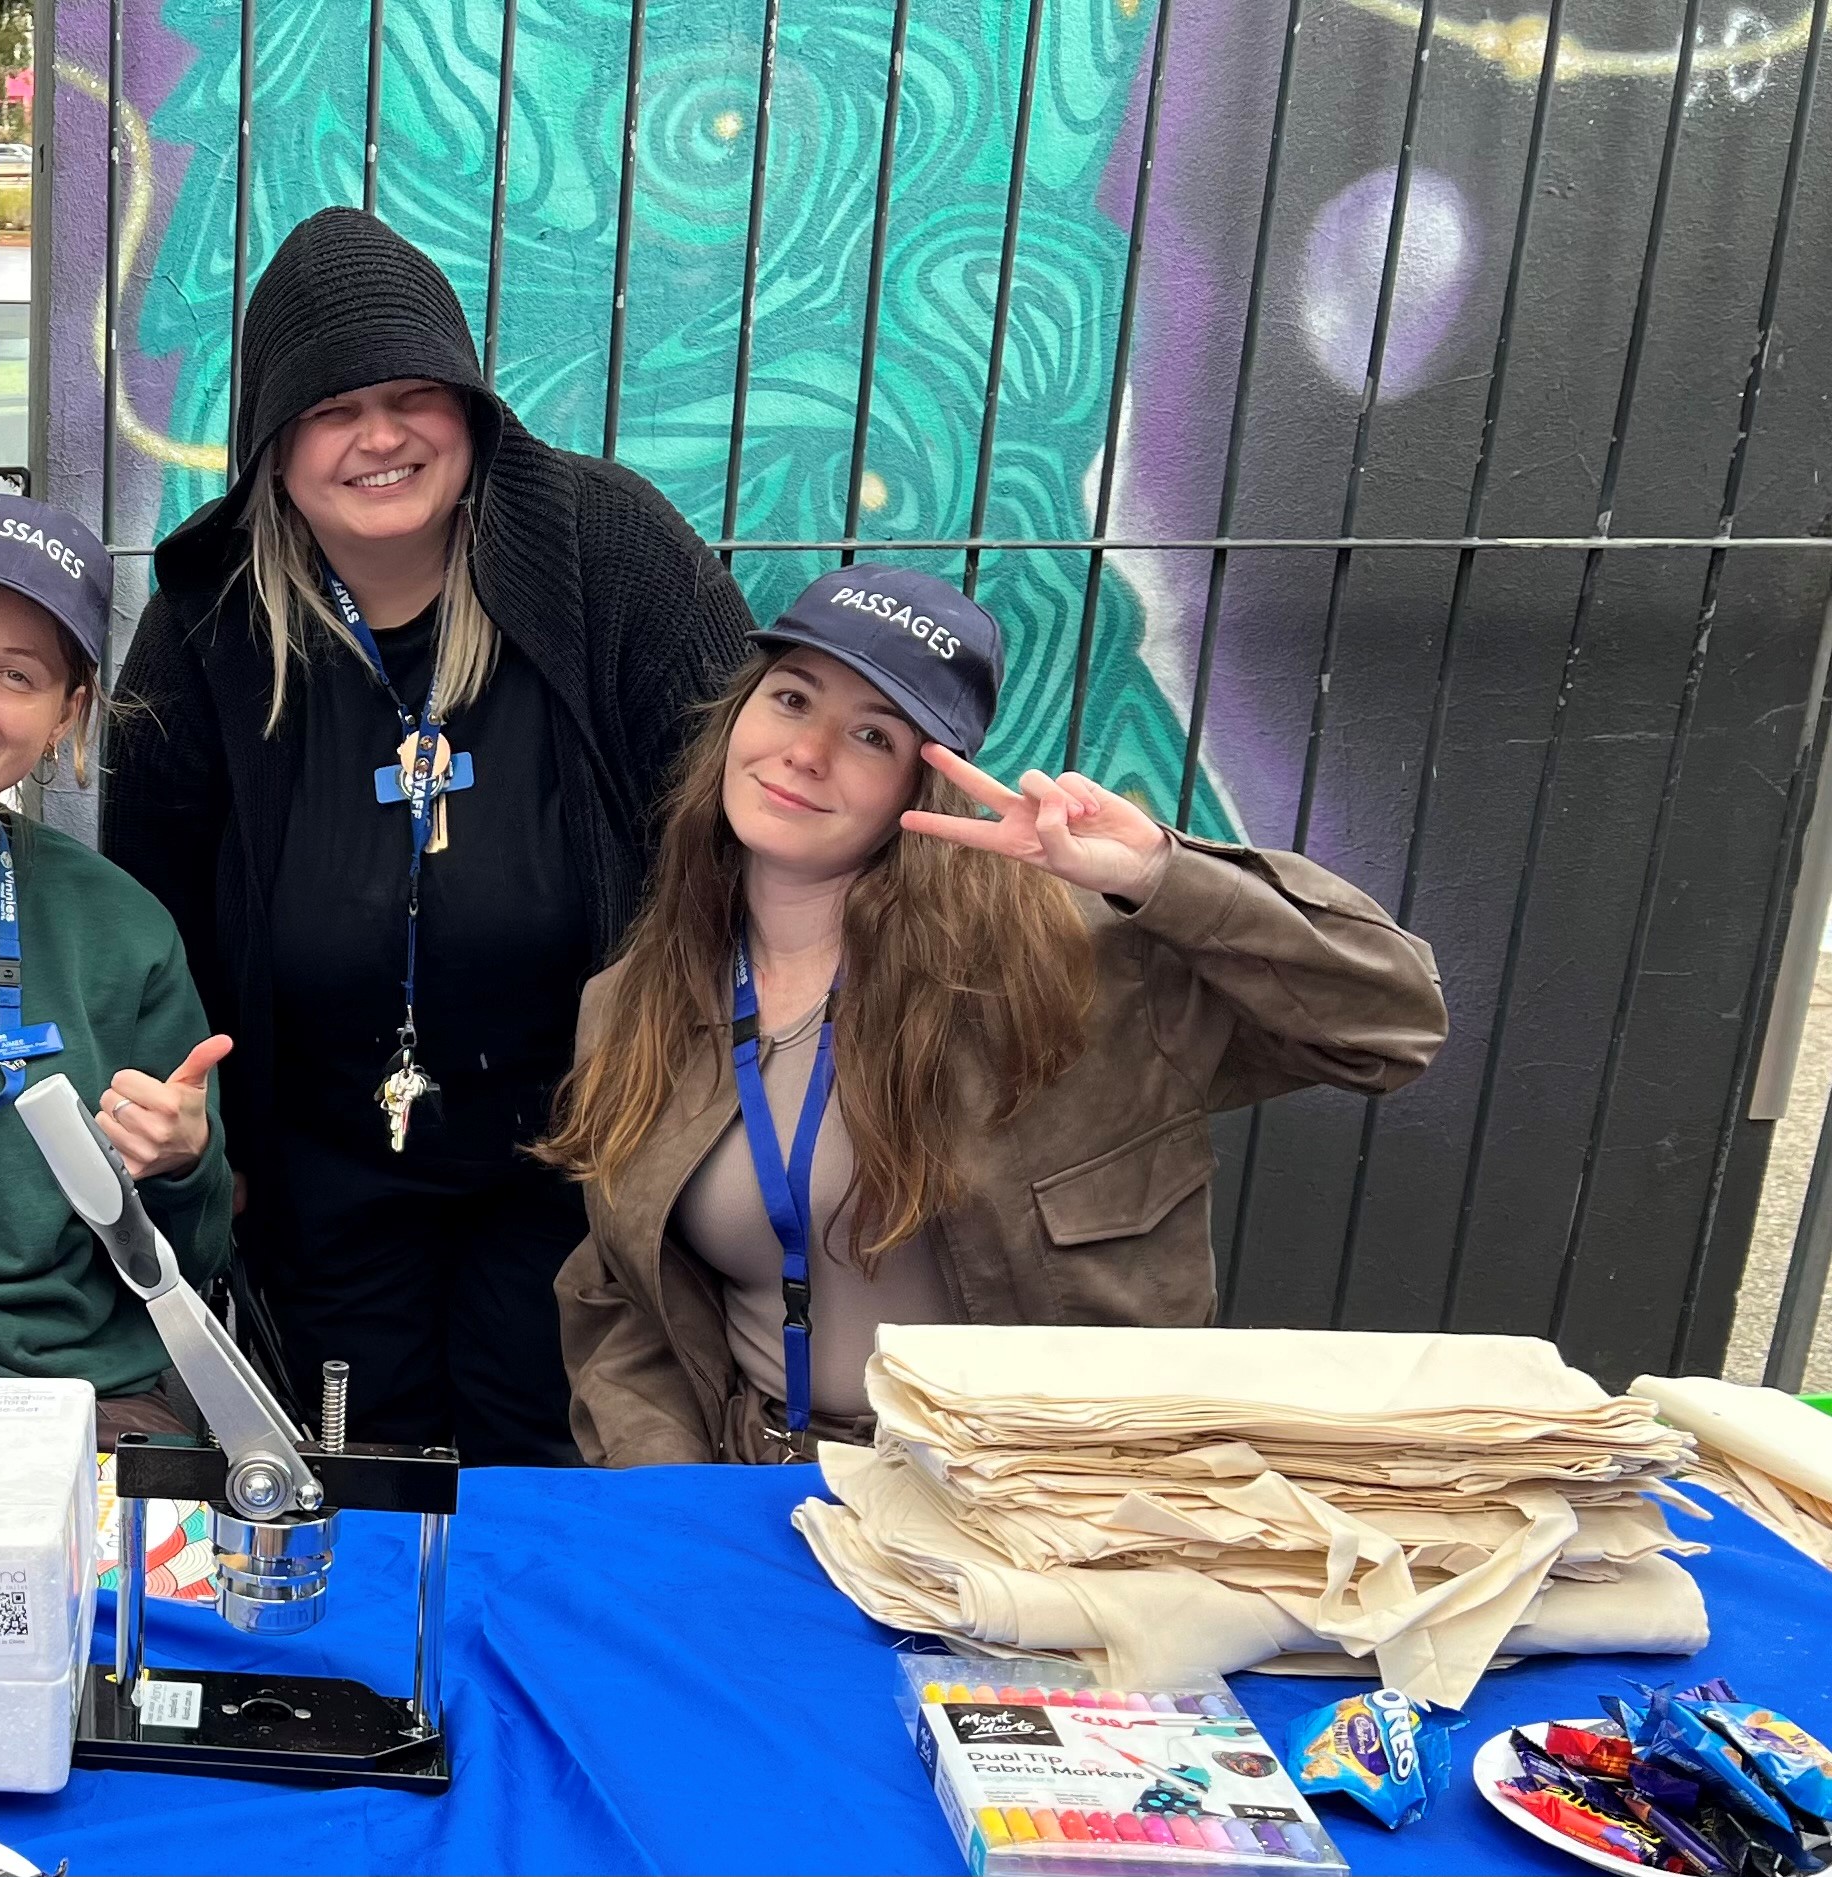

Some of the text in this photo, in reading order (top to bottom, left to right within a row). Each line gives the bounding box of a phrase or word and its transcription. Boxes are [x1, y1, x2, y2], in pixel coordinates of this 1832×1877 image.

[331, 579, 360, 624] STAFF
[830, 587, 961, 660] PASSAGES
[411, 769, 428, 820] STAFF
[4, 870, 16, 923] Vinnies
[958, 1711, 1015, 1727] Mont
[1371, 1688, 1415, 1779] OREO
[967, 1752, 1063, 1766] Dual Tip
[972, 1763, 1145, 1780] Fabric Markers
